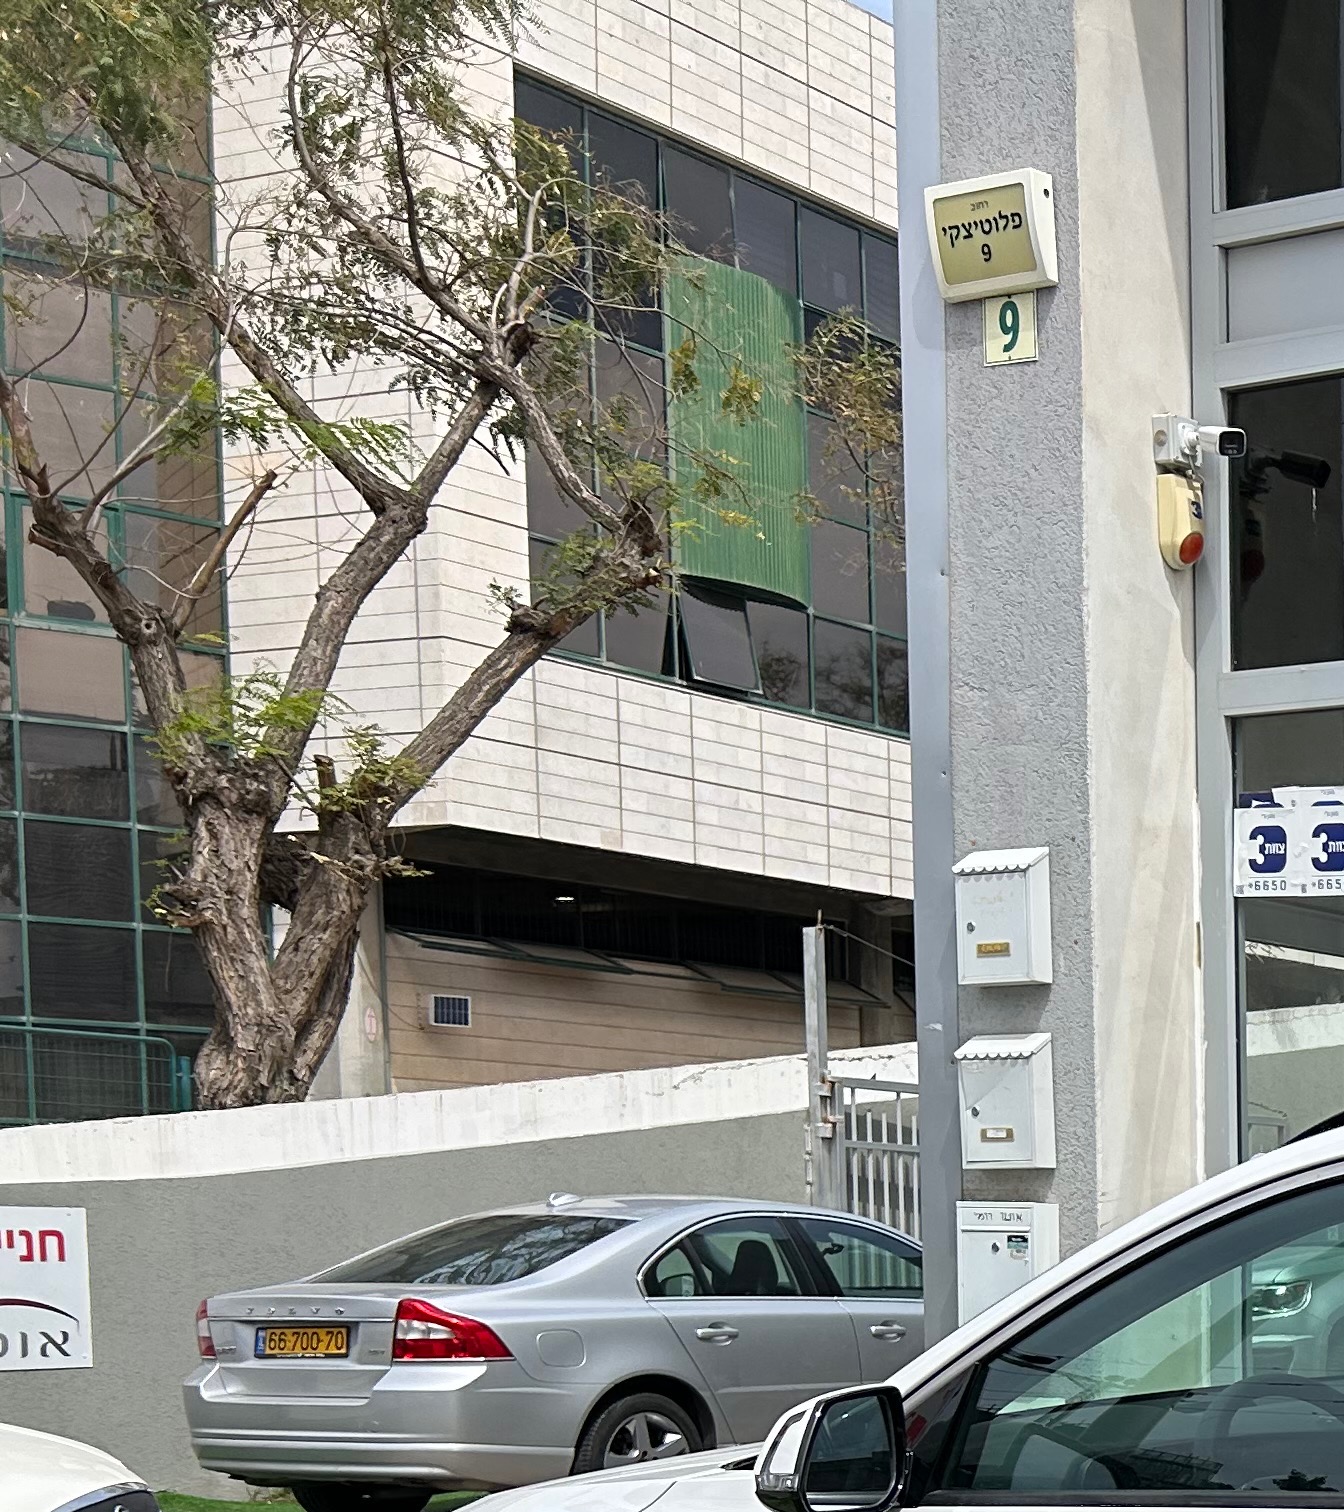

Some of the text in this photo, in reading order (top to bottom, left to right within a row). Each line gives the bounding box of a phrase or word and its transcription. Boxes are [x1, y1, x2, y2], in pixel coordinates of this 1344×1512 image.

[942, 210, 1023, 248] פלוטיצקי
[981, 243, 992, 263] 9
[999, 301, 1020, 353] 9
[0, 1229, 66, 1262] חני
